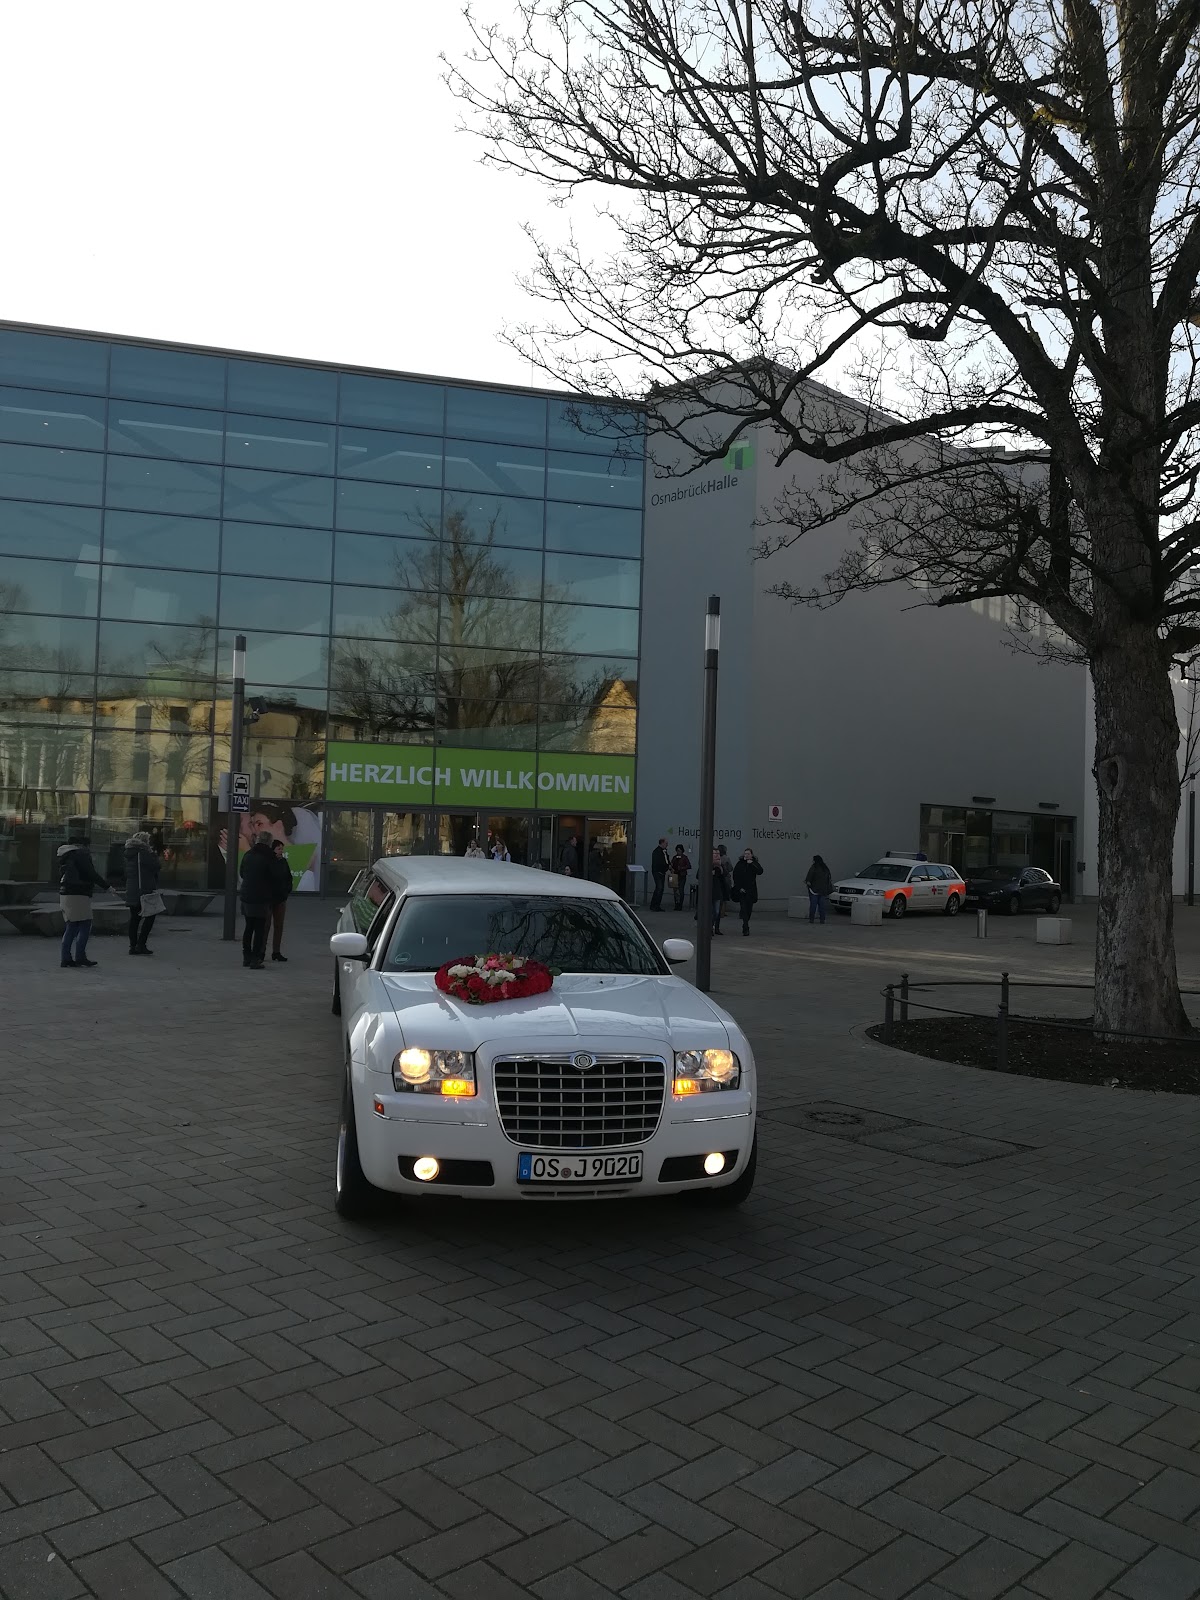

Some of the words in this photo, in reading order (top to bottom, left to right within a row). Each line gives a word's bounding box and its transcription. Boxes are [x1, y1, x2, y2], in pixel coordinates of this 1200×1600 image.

[651, 475, 738, 506] OsnabrückHalle
[330, 762, 451, 786] HERZLICH
[460, 768, 630, 794] WILLKOMMEN
[233, 795, 249, 805] TAXI
[678, 826, 742, 840] Haupngang
[752, 828, 801, 840] Ticket-Service
[533, 1157, 560, 1178] OS
[574, 1159, 587, 1178] J
[592, 1156, 639, 1177] 9020
